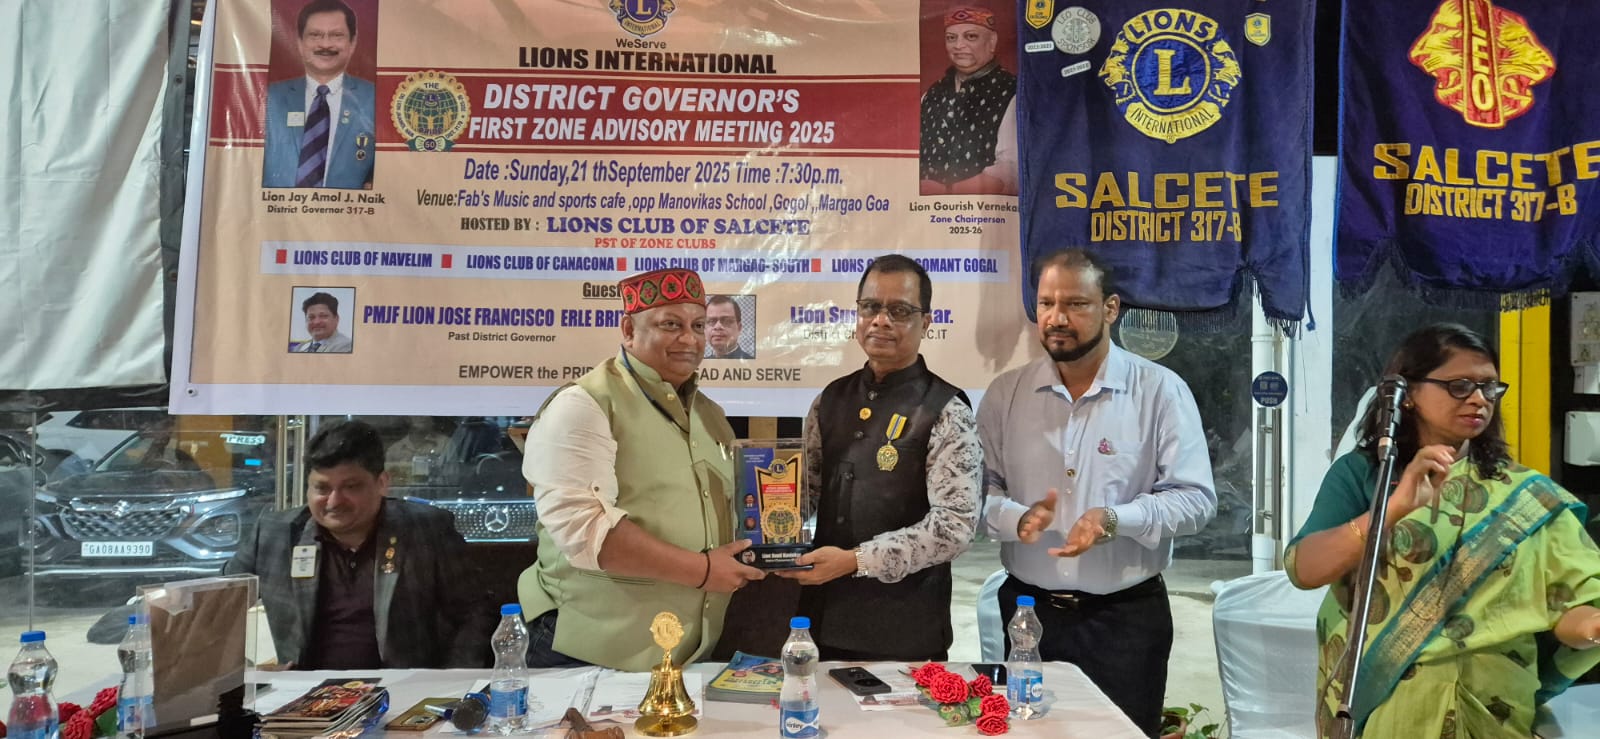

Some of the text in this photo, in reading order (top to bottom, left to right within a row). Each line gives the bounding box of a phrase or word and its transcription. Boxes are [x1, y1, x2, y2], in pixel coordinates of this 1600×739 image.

[1127, 12, 1215, 39] LIONS
[615, 38, 667, 49] WeServe
[519, 46, 777, 74] LIONS INTERNATIONAL
[1469, 0, 1495, 111] LEO
[1153, 48, 1192, 96] L
[483, 84, 616, 111] DISTRICT
[469, 117, 835, 145] FIRST ZONE ADVISORY MEETING 2025
[1130, 107, 1215, 135] INTERNATIONAL
[464, 158, 499, 180] Date
[593, 160, 692, 187] thSeptember
[694, 162, 731, 184] 2025
[736, 161, 771, 183] Time
[1374, 140, 1600, 190] SALCETE
[262, 191, 386, 204] Lion Jay Amol J. Naik
[493, 190, 530, 208] Music
[532, 192, 556, 208] and
[558, 192, 597, 213] sports
[600, 192, 626, 210] cafe
[658, 193, 722, 211] Manovikas
[725, 193, 767, 211] School
[866, 194, 890, 211] Goa
[1055, 171, 1280, 209] SALCETE
[267, 205, 376, 216] District Governor 317-B
[909, 200, 1019, 213] Lion Gourish Verneka
[1404, 183, 1578, 223] DISTRICT 317-B
[461, 217, 510, 231] HOSTED
[513, 217, 531, 231] BY
[546, 216, 613, 233] LIONS
[618, 218, 675, 234] CLUB
[680, 218, 709, 234] OF
[714, 219, 811, 235] SALCETE
[930, 214, 1006, 225] Zone Chairperson
[949, 226, 983, 235] 2025-26
[1090, 210, 1242, 243] DISTRICT 317-B
[594, 238, 716, 249] PST OF ZONE CLUBS
[294, 250, 328, 265] LIONS
[331, 251, 360, 266] CLUB
[364, 252, 379, 266] OF
[381, 252, 432, 267] NAVELIM
[467, 254, 501, 269] LIONS
[504, 255, 533, 270] CLUB
[536, 256, 550, 270] OF
[552, 256, 615, 271] CANACONA
[634, 257, 667, 272] LIONS
[702, 258, 715, 272] OF
[772, 258, 810, 273] SOUTH
[832, 258, 864, 273] LIONS
[964, 258, 998, 273] GOGAL
[363, 305, 401, 324] PMJF
[403, 306, 435, 324] LION
[438, 307, 472, 325] JOSE
[474, 308, 555, 326] FRANCISCO
[561, 309, 592, 327] ERLE
[790, 306, 826, 324] Lion
[448, 331, 556, 342] Past District Governor
[459, 365, 533, 379] EMPOWER
[537, 366, 558, 379] the
[723, 369, 752, 381] AND
[756, 368, 801, 381] SERVE
[229, 435, 263, 444] PRESS
